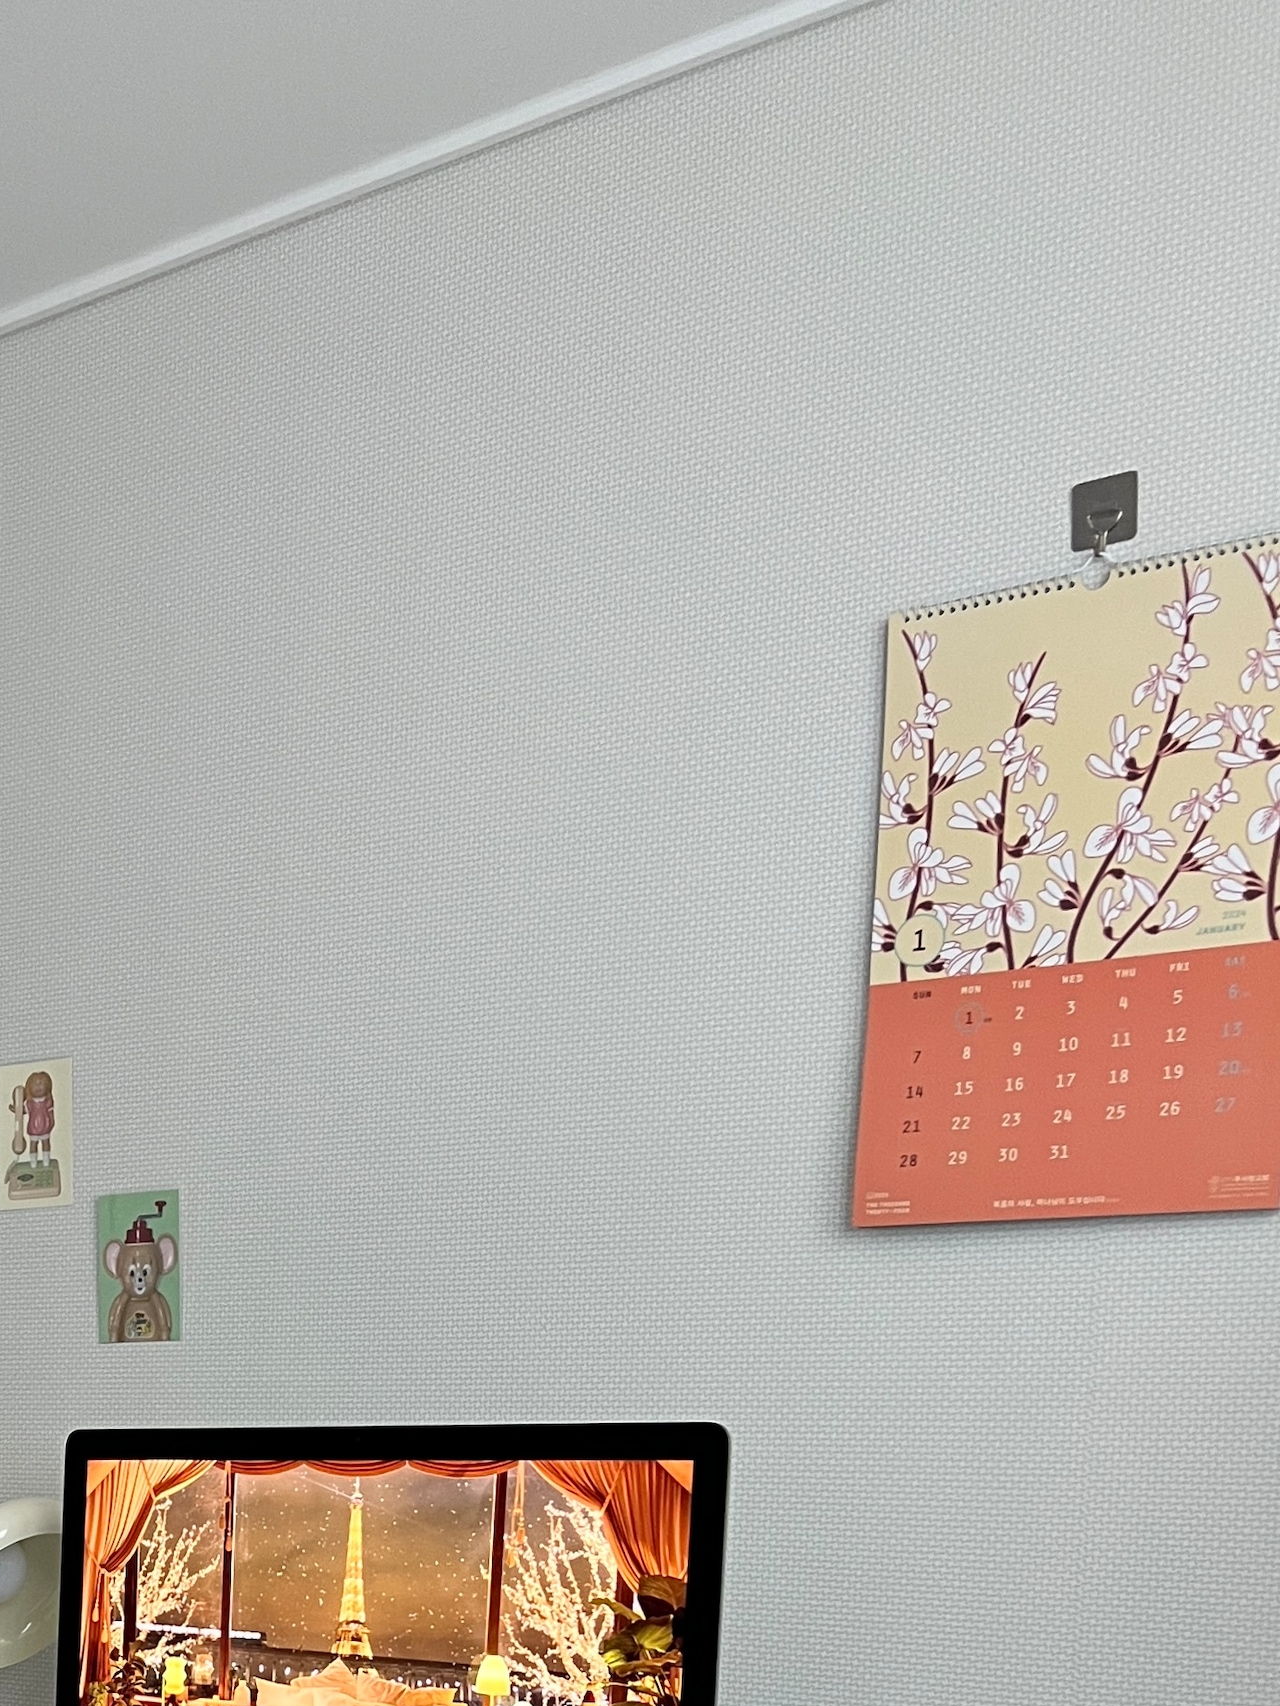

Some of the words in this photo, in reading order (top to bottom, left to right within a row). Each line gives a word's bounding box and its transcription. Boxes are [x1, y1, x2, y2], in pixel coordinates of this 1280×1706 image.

[912, 928, 926, 952] 1
[961, 986, 981, 994] MON
[1012, 980, 1031, 988] TUE
[1062, 974, 1083, 983] WED
[1115, 968, 1136, 978] THU
[1170, 962, 1189, 972] FRI
[965, 1011, 974, 1025] 1
[1014, 1005, 1025, 1021] 2
[1066, 1000, 1076, 1015] 3
[1118, 996, 1129, 1010] 4
[1172, 989, 1183, 1005] 5
[1227, 984, 1239, 1000] 6
[912, 1050, 922, 1064] 7
[962, 1045, 971, 1060] 8
[1012, 1041, 1022, 1057] 9
[1058, 1036, 1079, 1053] 10
[1110, 1031, 1132, 1048] 11
[1164, 1026, 1187, 1043] 12
[1221, 1021, 1243, 1039] 13
[905, 1085, 924, 1100] 14
[953, 1080, 974, 1096] 15
[1004, 1076, 1024, 1092] 16
[1055, 1072, 1077, 1089] 17
[1108, 1068, 1129, 1085] 18
[1162, 1064, 1184, 1080] 19
[902, 1119, 921, 1134] 21
[951, 1115, 971, 1131] 22
[1001, 1112, 1022, 1128] 23
[1052, 1109, 1073, 1124] 24
[1105, 1103, 1127, 1121] 25
[1159, 1100, 1181, 1117] 26
[1214, 1096, 1237, 1114] 27
[899, 1153, 918, 1168] 28
[947, 1150, 968, 1166] 29
[998, 1147, 1019, 1163] 30
[1049, 1144, 1069, 1160] 31
